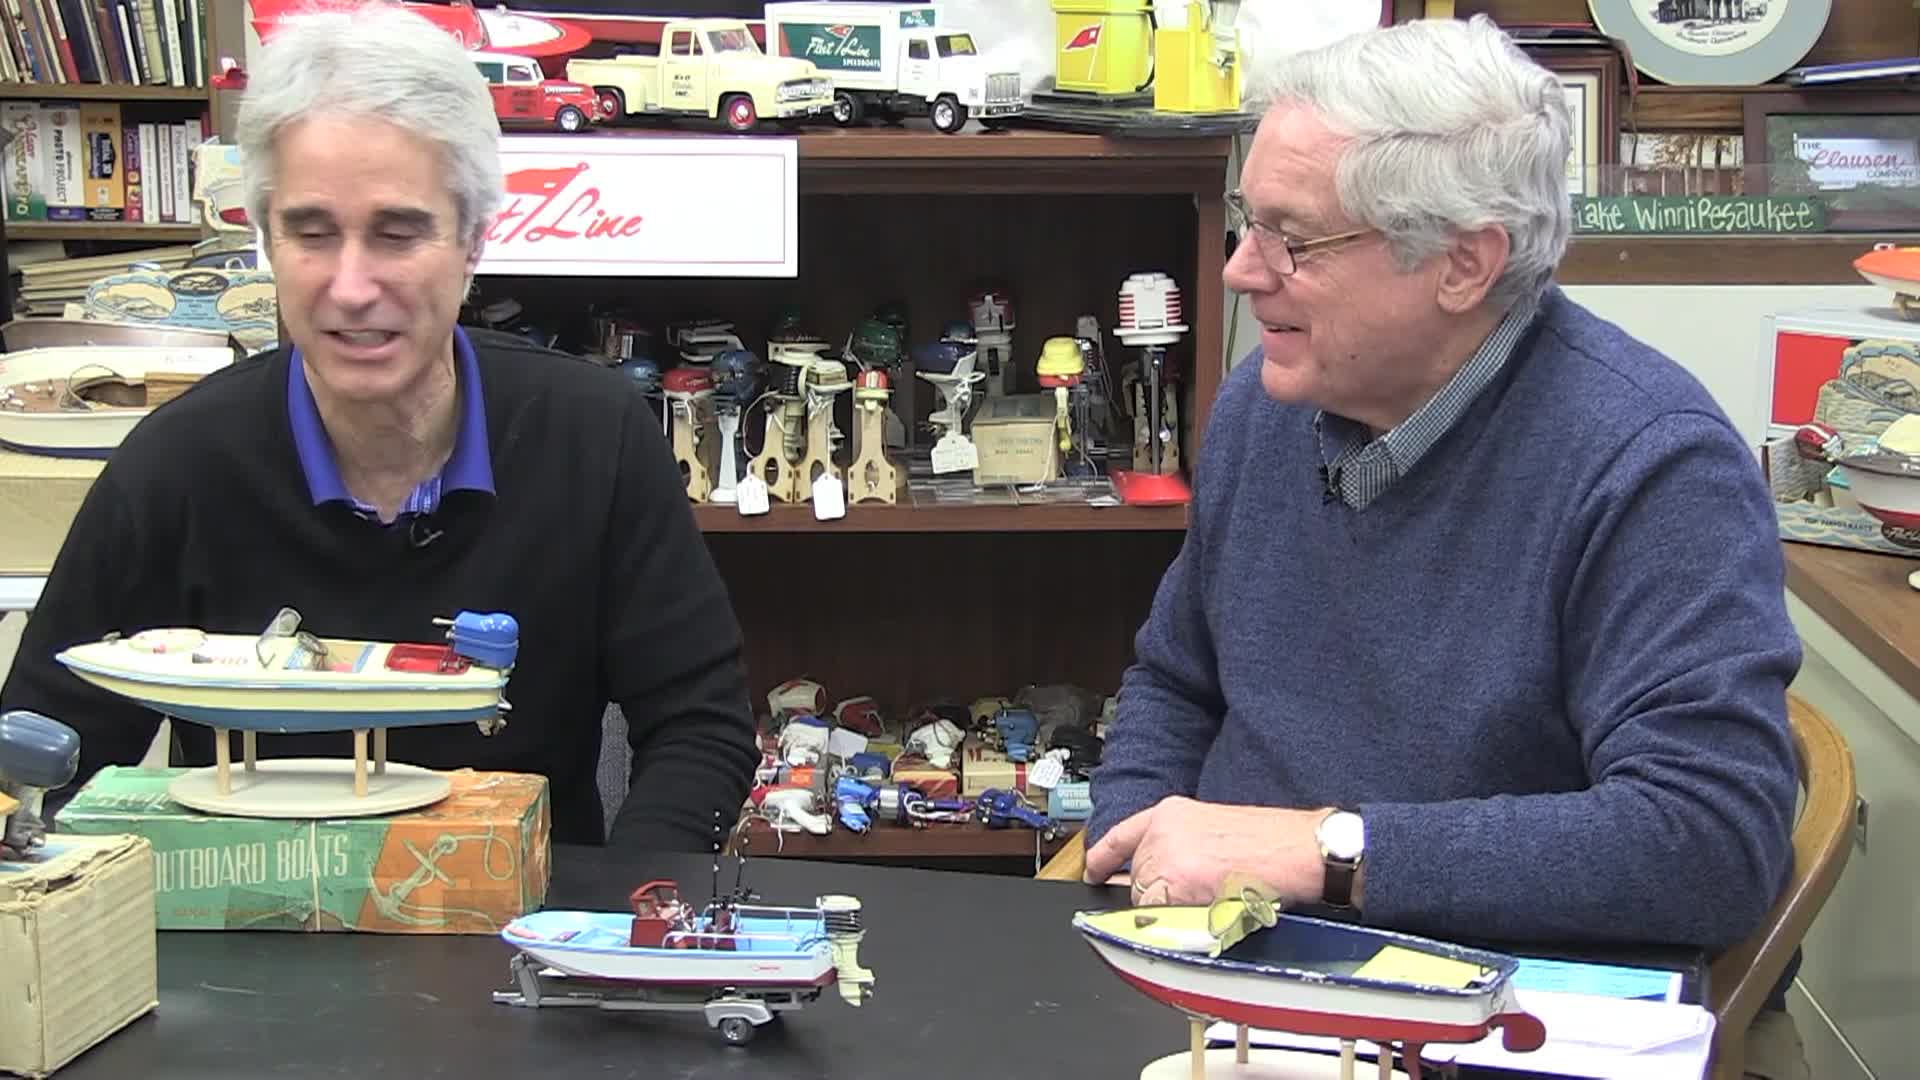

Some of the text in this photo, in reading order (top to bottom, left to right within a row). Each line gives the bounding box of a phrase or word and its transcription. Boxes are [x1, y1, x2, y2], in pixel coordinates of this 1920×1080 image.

[1801, 142, 1821, 150] THE
[1808, 149, 1905, 169] Clausen
[55, 163, 68, 204] PROJECT
[524, 187, 643, 242] Line
[1577, 200, 1625, 232] Lake
[276, 833, 349, 882] BOATS
